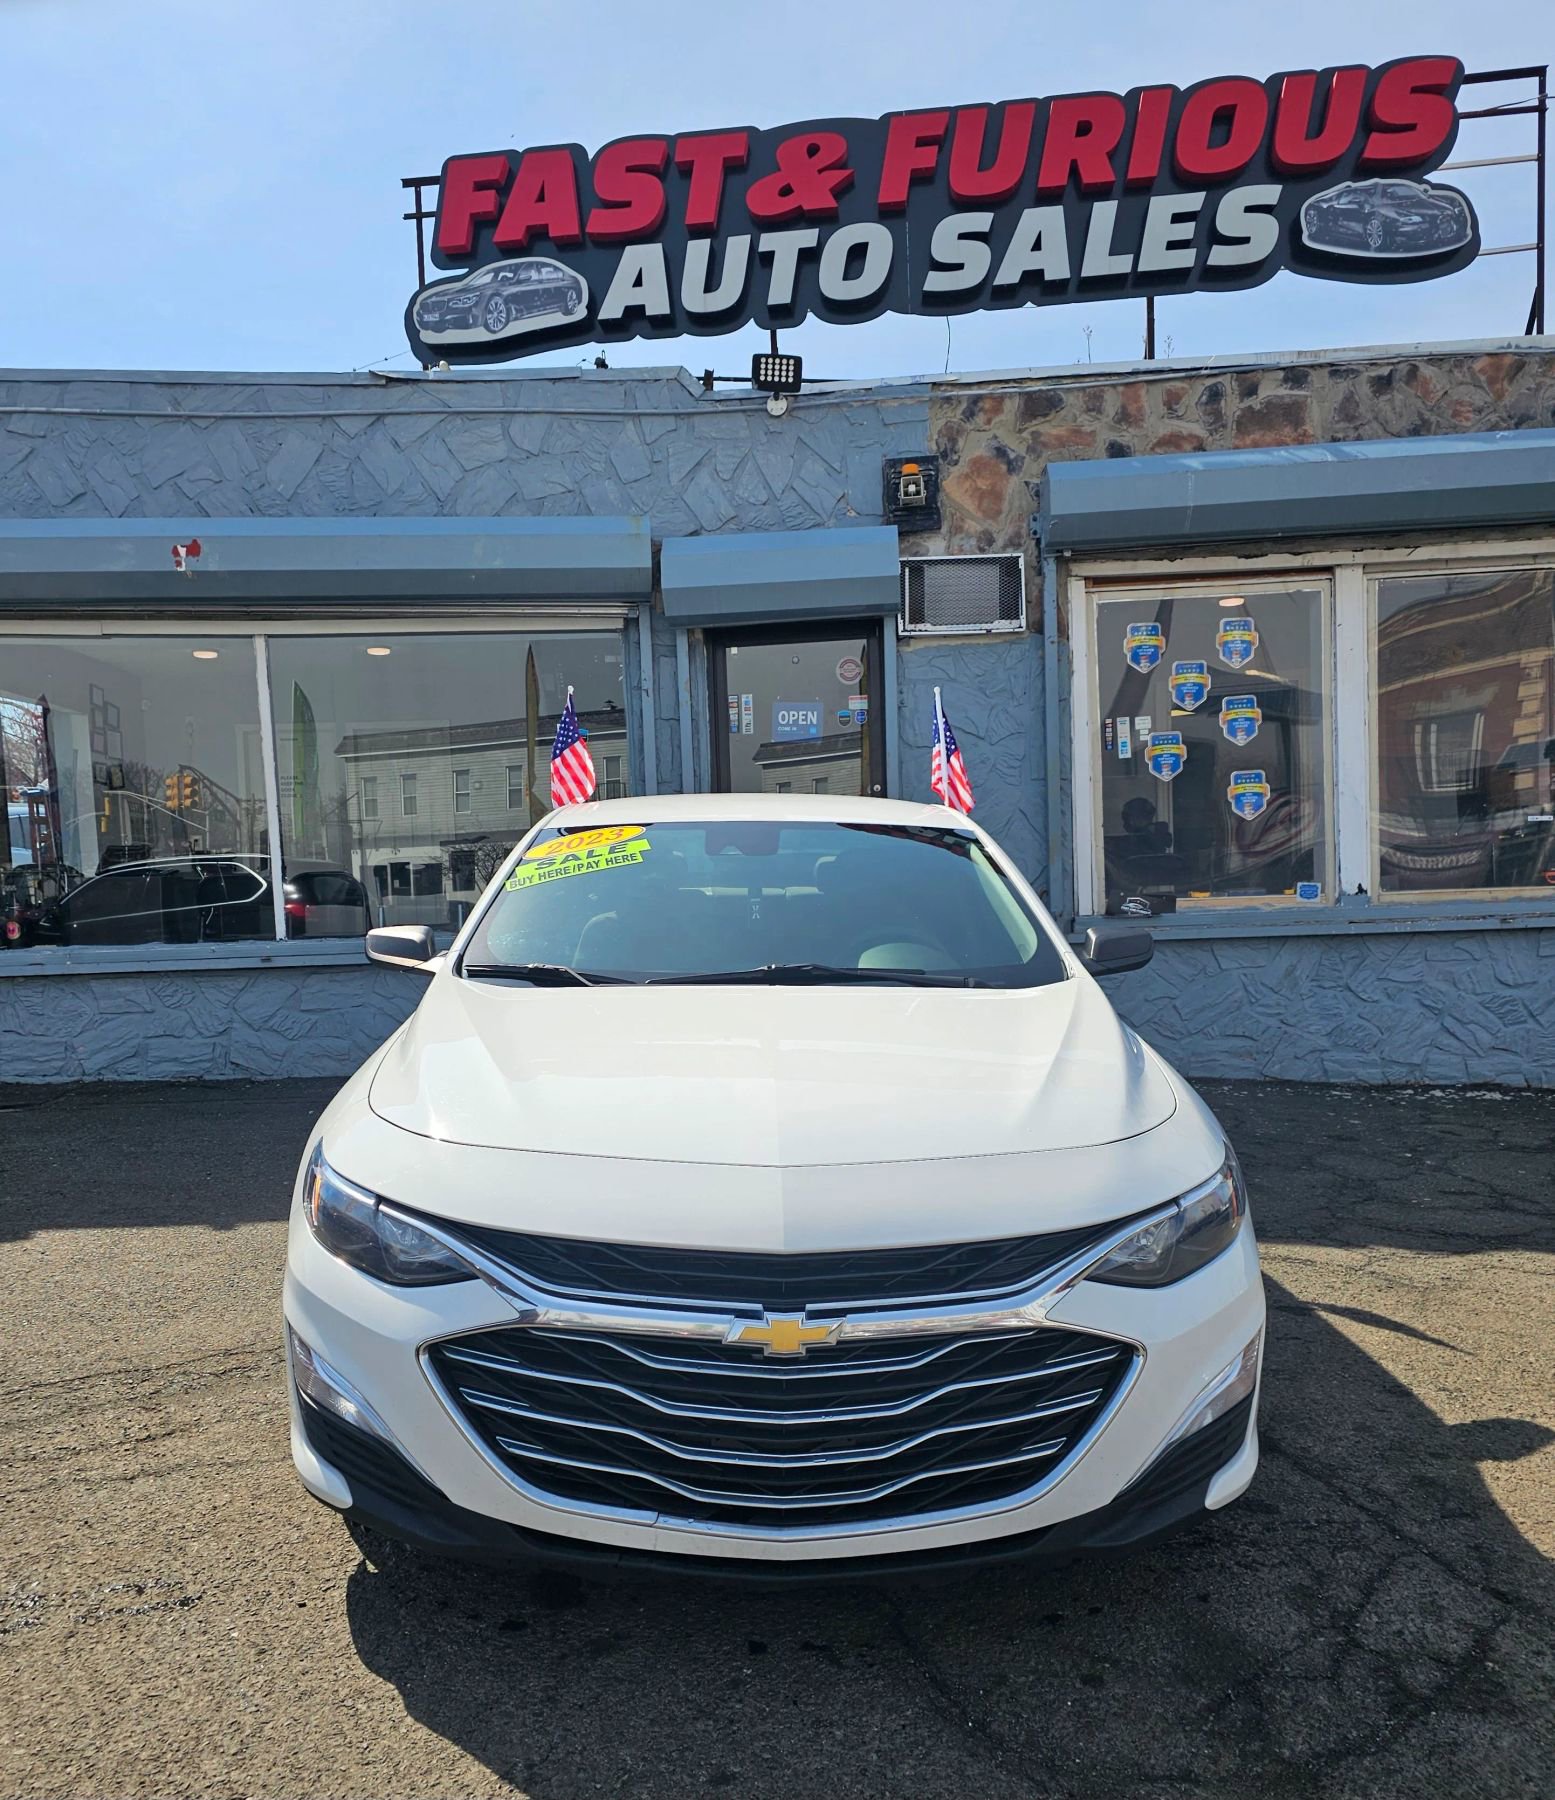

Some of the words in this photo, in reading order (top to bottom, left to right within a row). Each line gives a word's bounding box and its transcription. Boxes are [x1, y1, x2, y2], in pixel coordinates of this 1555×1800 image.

[437, 131, 749, 254] FAST
[746, 131, 854, 222] &
[878, 56, 1459, 211] FURIOUS
[597, 221, 894, 320] AUTO
[922, 183, 1283, 292] SALES
[778, 710, 817, 725] OPEN
[535, 842, 628, 870] SALE
[546, 828, 624, 854] 2023
[509, 874, 534, 890] BUY
[538, 859, 600, 881] HERE/PAY
[605, 852, 637, 866] HERE
